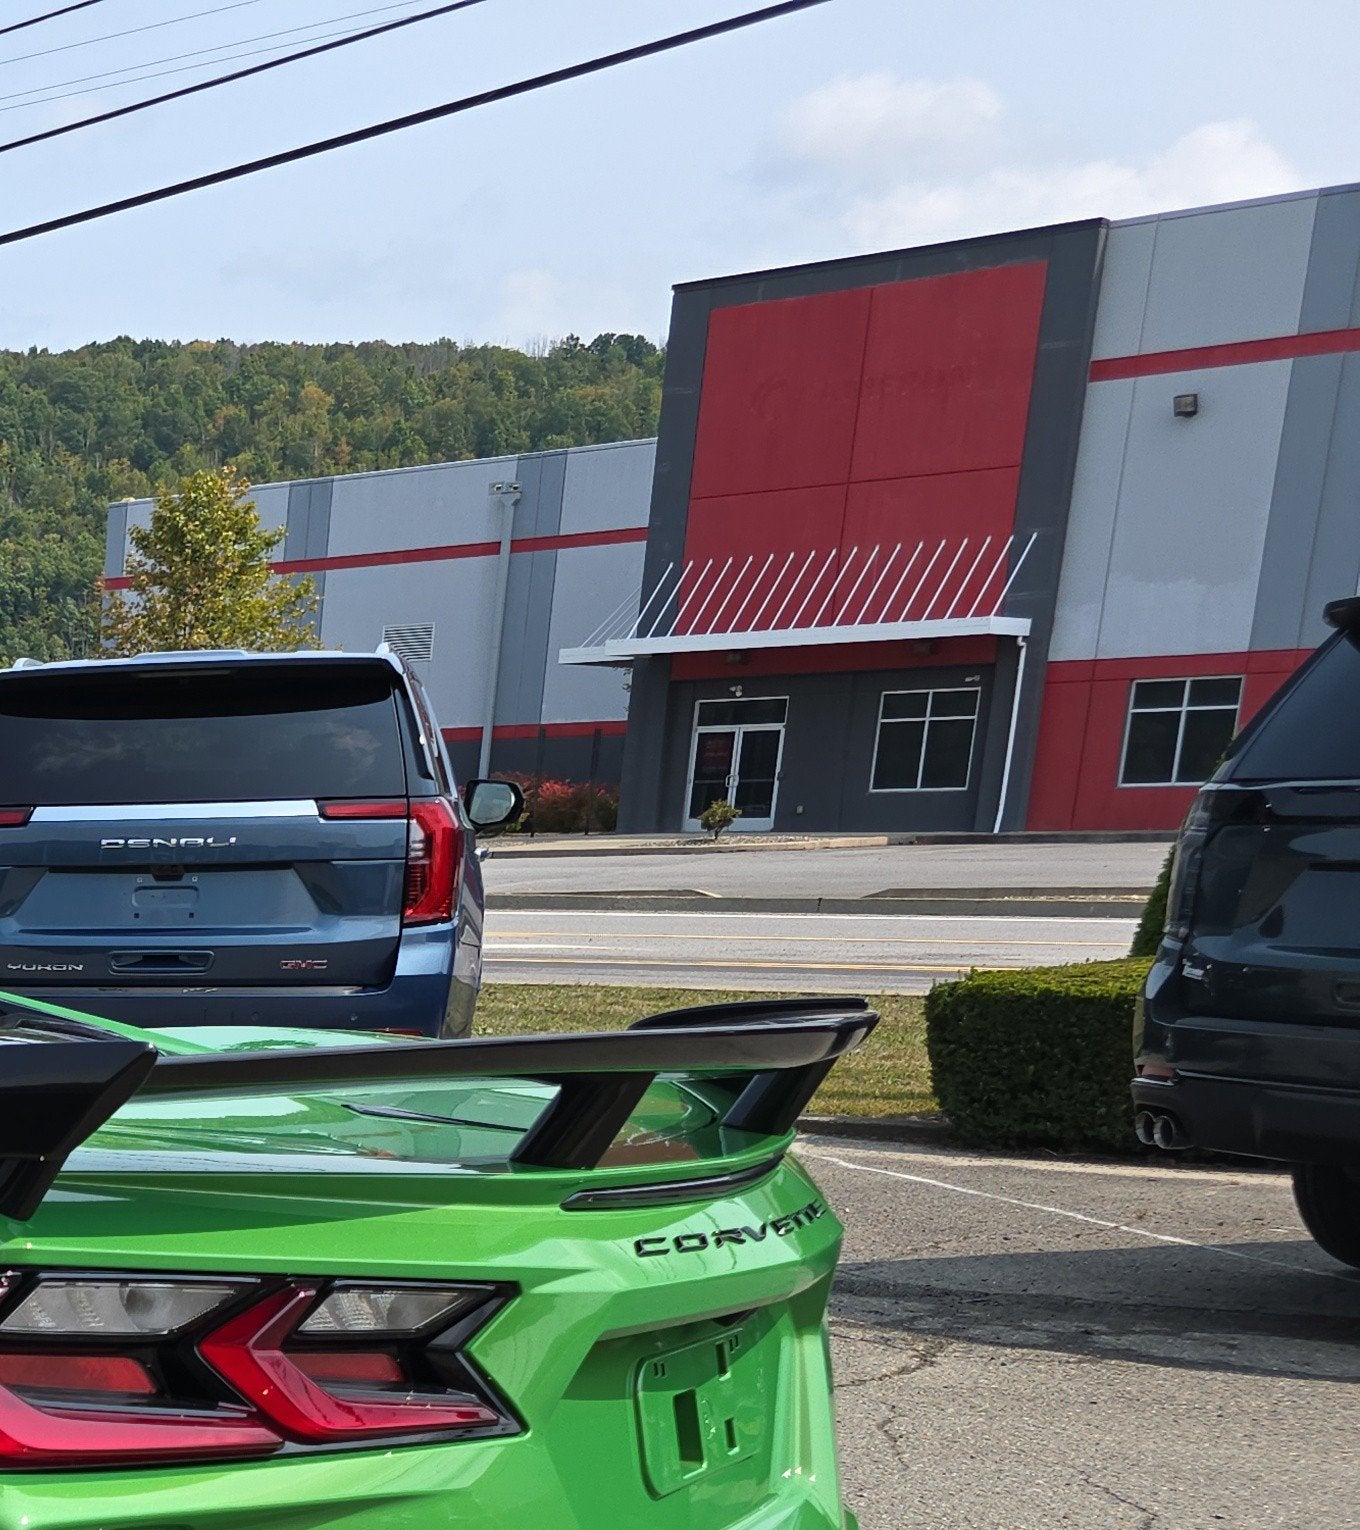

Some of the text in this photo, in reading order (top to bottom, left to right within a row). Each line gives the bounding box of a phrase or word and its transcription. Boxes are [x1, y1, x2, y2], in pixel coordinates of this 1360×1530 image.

[100, 836, 237, 850] DENALI
[7, 962, 84, 972] YUKON
[280, 959, 328, 970] GMC
[633, 1198, 827, 1259] CORVETTE
